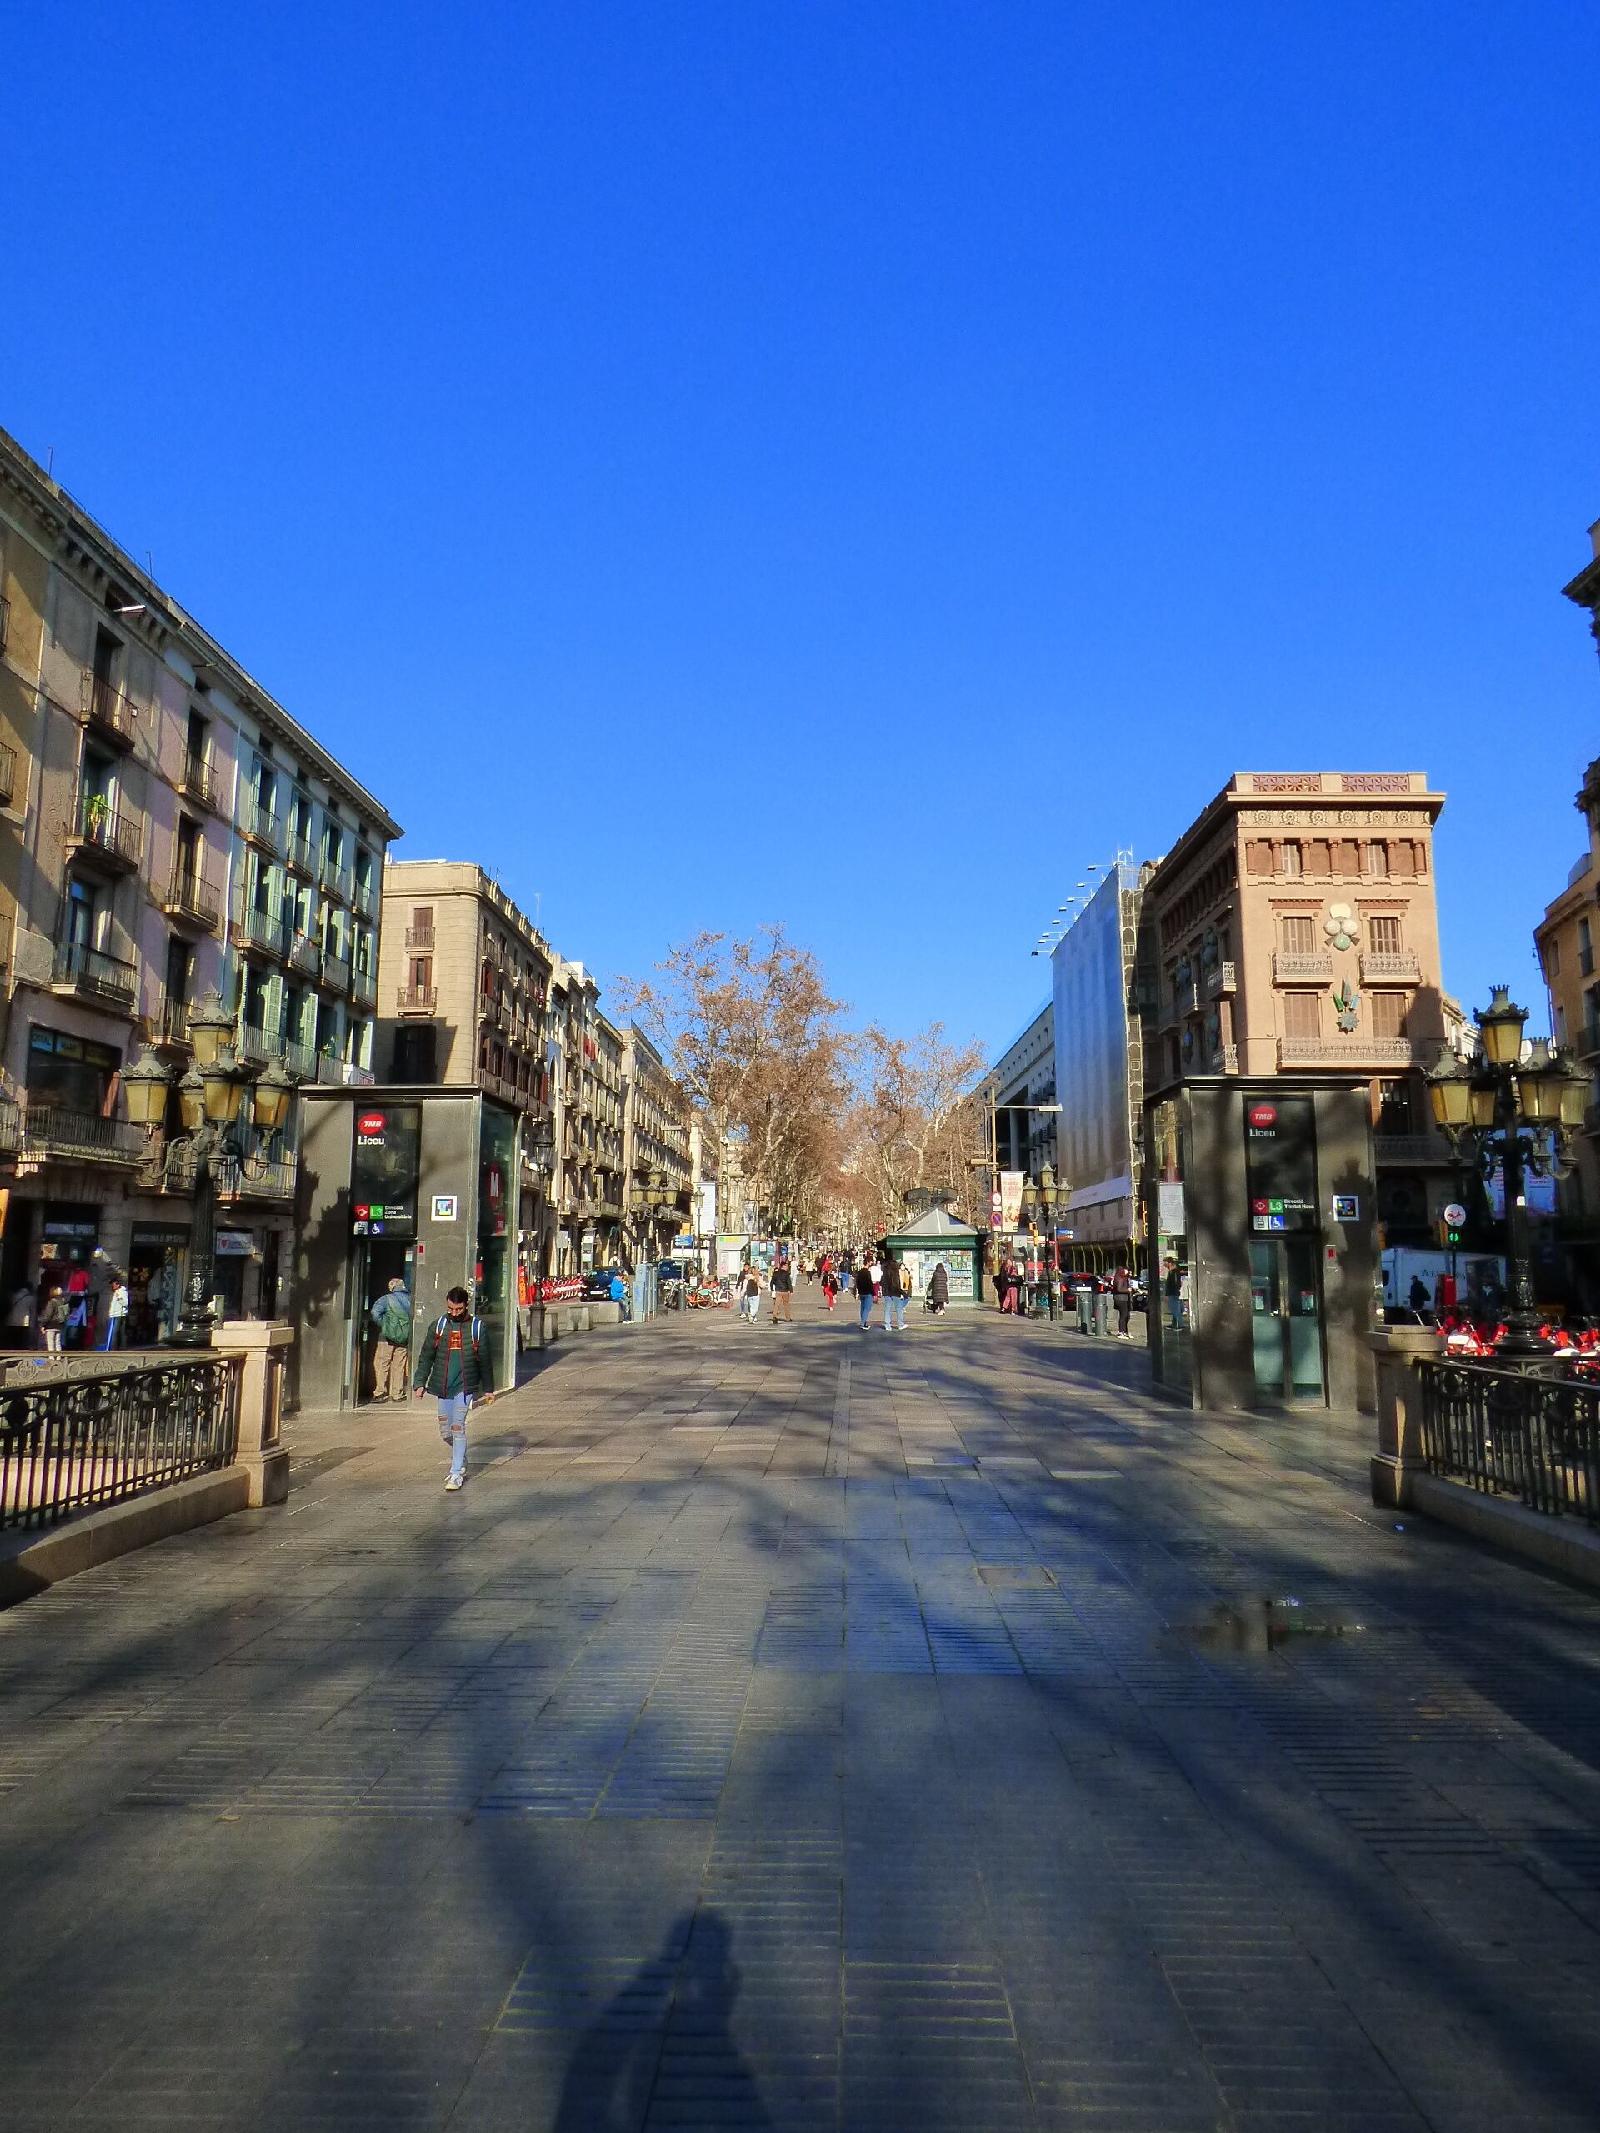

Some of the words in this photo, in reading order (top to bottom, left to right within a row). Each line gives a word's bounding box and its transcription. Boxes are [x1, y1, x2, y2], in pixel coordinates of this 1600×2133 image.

[1249, 1128, 1276, 1137] Liceu
[1269, 1201, 1283, 1211] L3
[370, 1207, 383, 1218] L3
